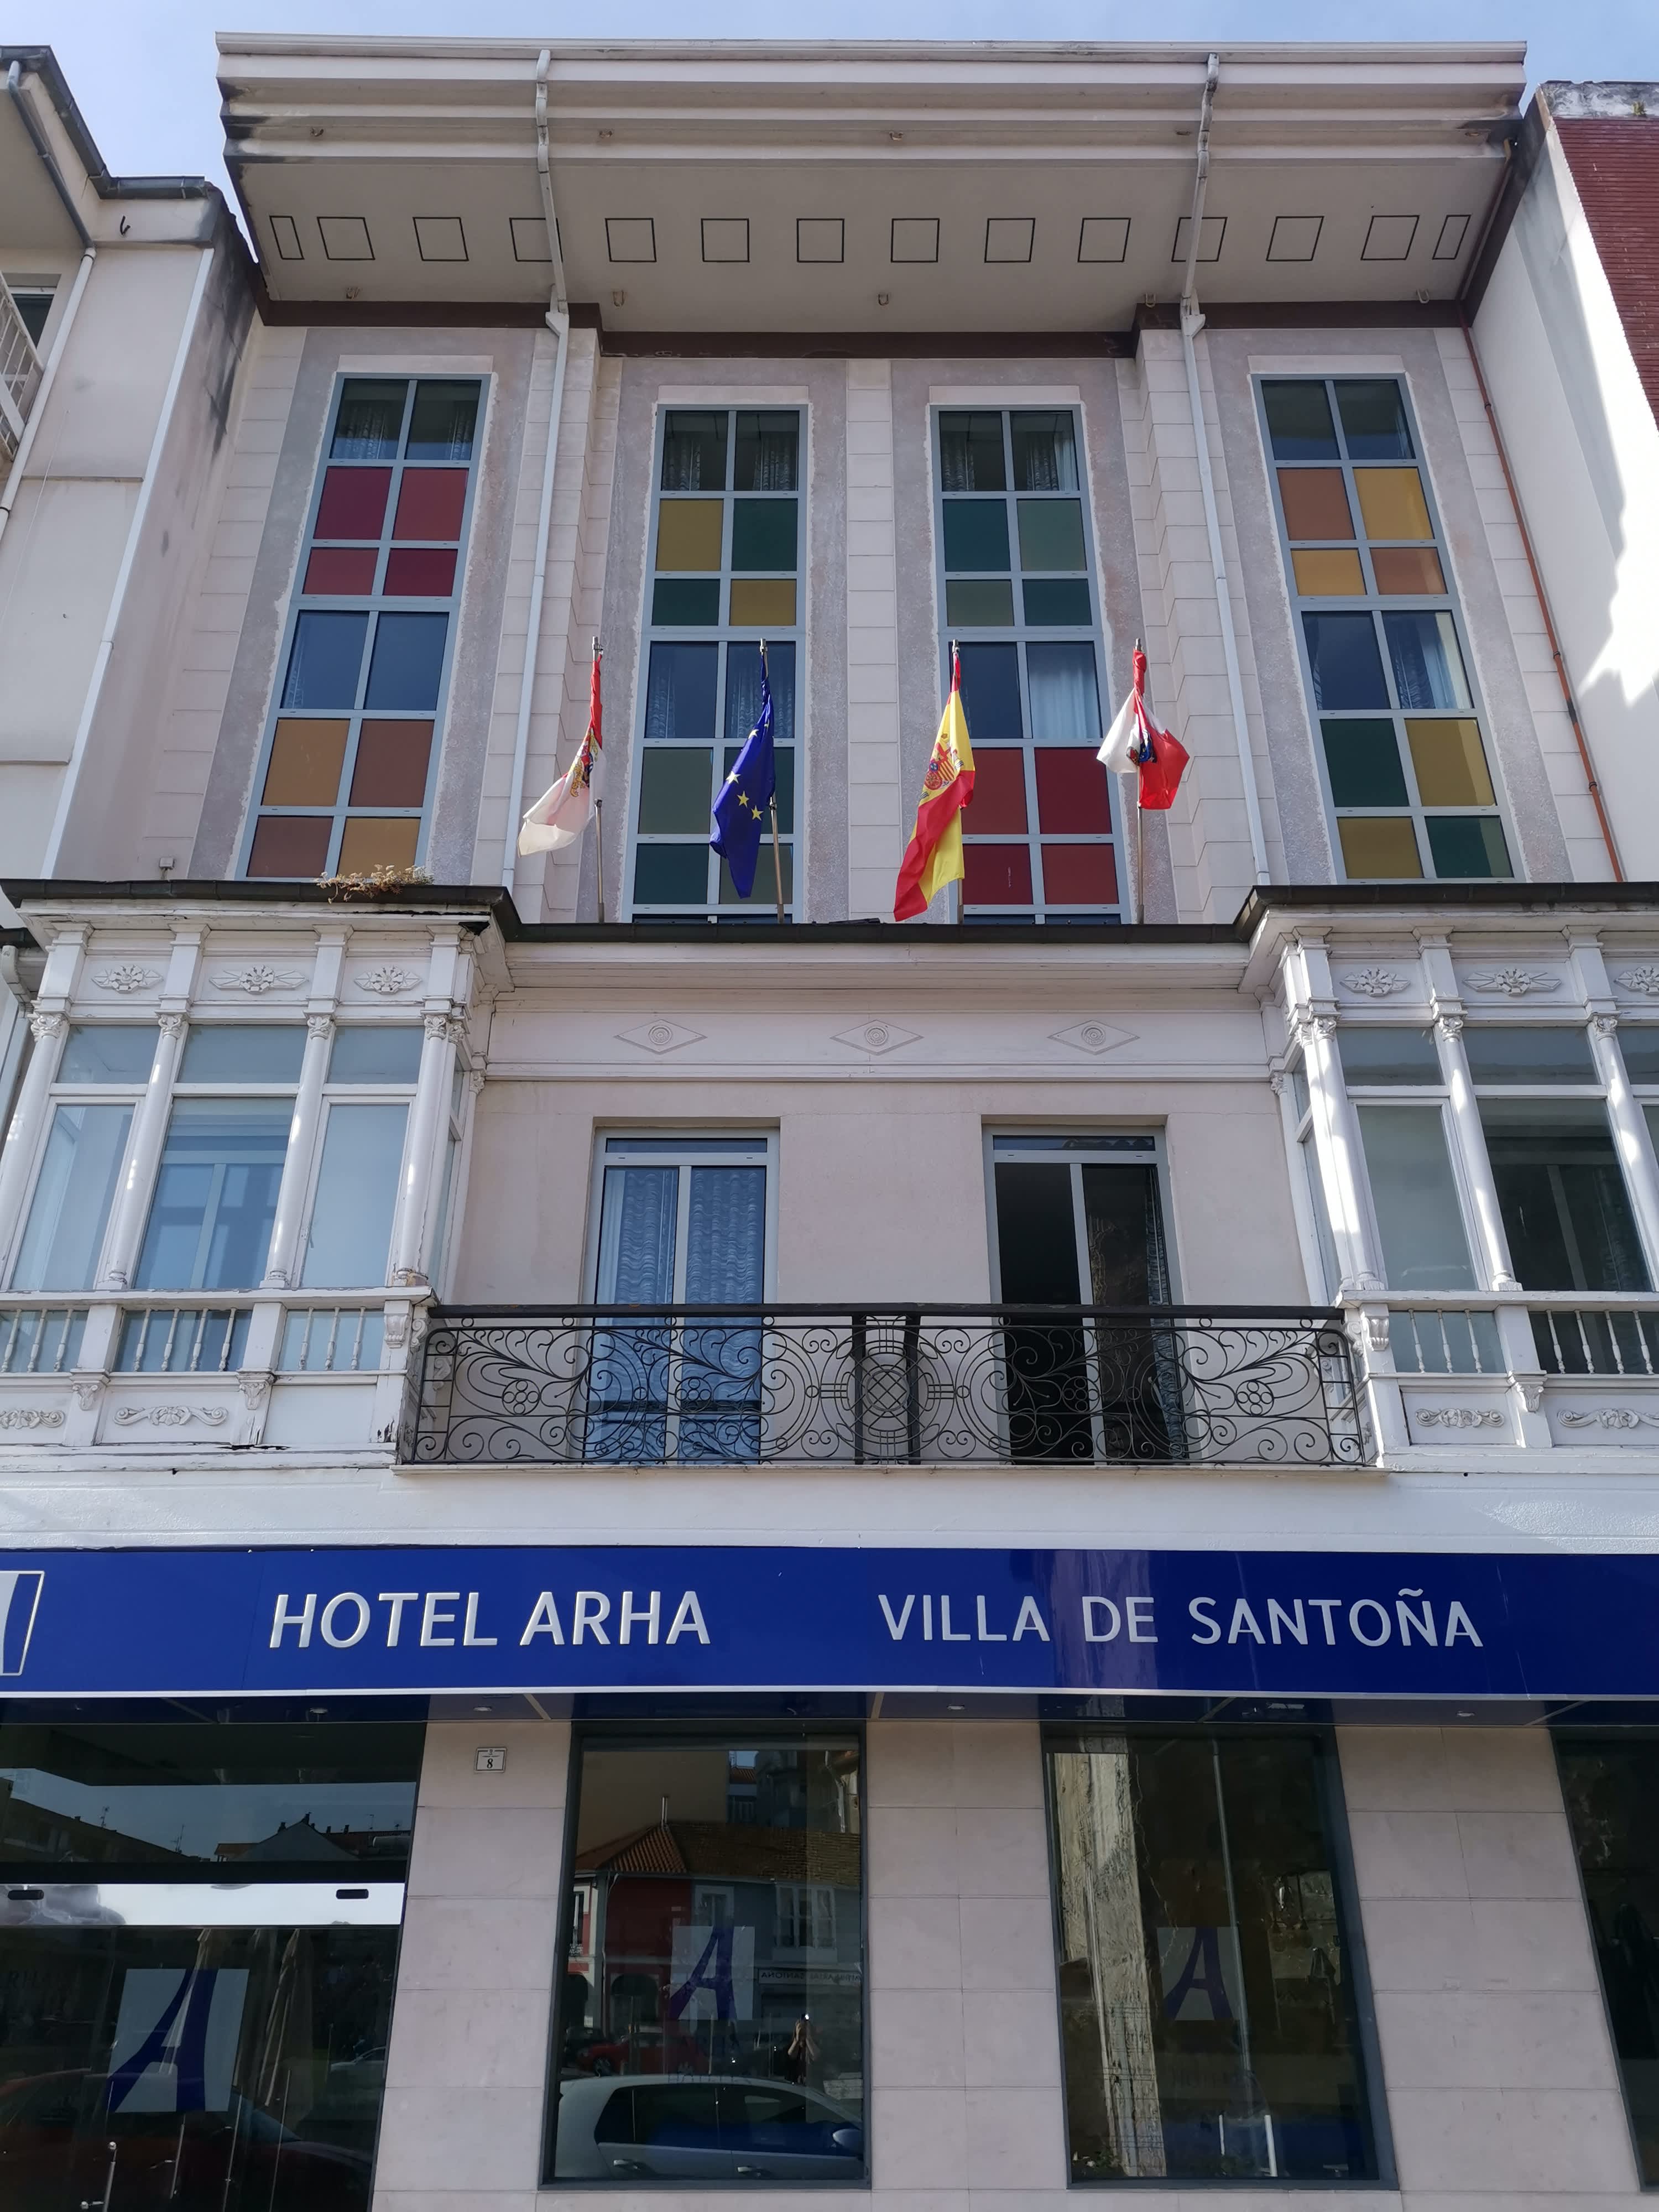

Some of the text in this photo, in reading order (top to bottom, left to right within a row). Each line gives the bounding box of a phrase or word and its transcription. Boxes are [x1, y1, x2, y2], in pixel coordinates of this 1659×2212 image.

[269, 1588, 1484, 1648] HOTEL ARHA VILLA DE SANTOÑA
[487, 1758, 494, 1769] 8
